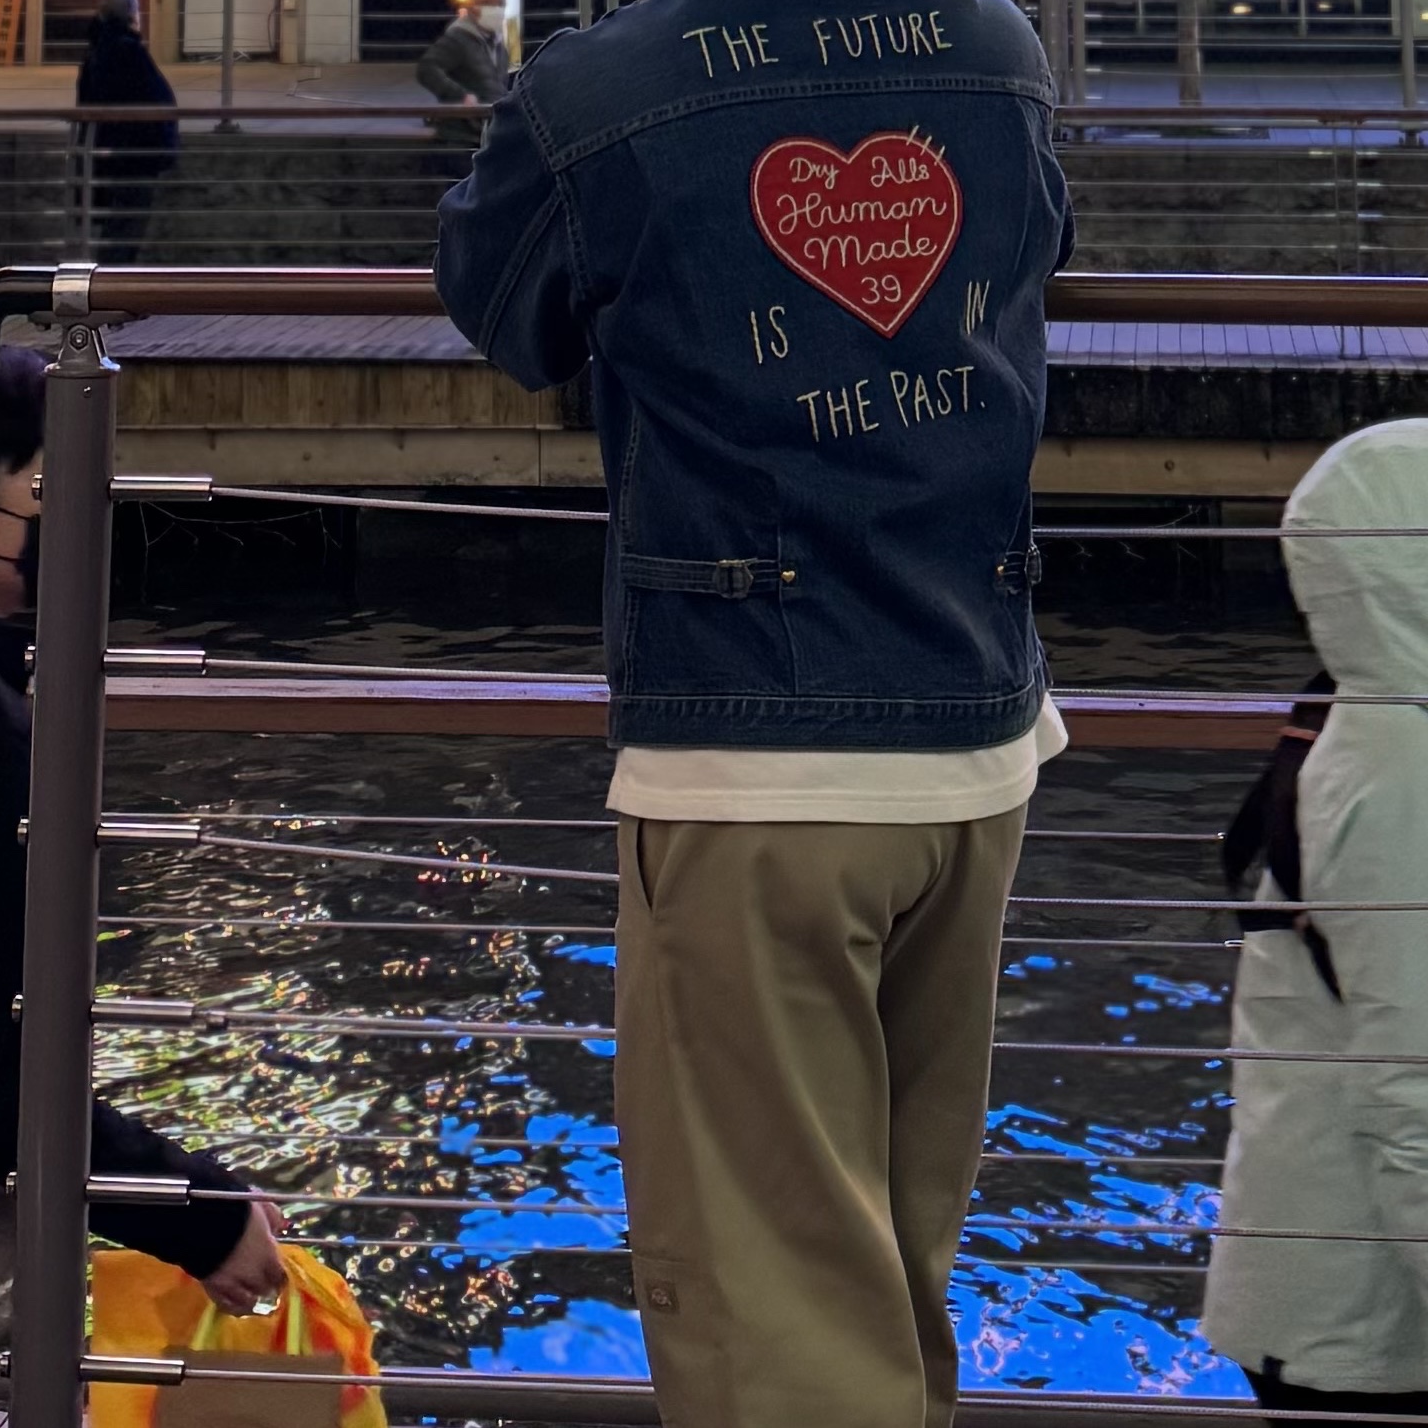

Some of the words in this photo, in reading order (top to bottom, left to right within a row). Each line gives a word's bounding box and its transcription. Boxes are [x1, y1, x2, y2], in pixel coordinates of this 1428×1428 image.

[683, 22, 779, 78] THE
[813, 10, 953, 66] FUTURE
[789, 157, 840, 189] Dry
[870, 156, 930, 187] Alls
[776, 192, 947, 235] Human
[803, 222, 938, 270] Made
[861, 274, 902, 304] 39
[750, 306, 790, 364] IS
[796, 381, 882, 442] THE
